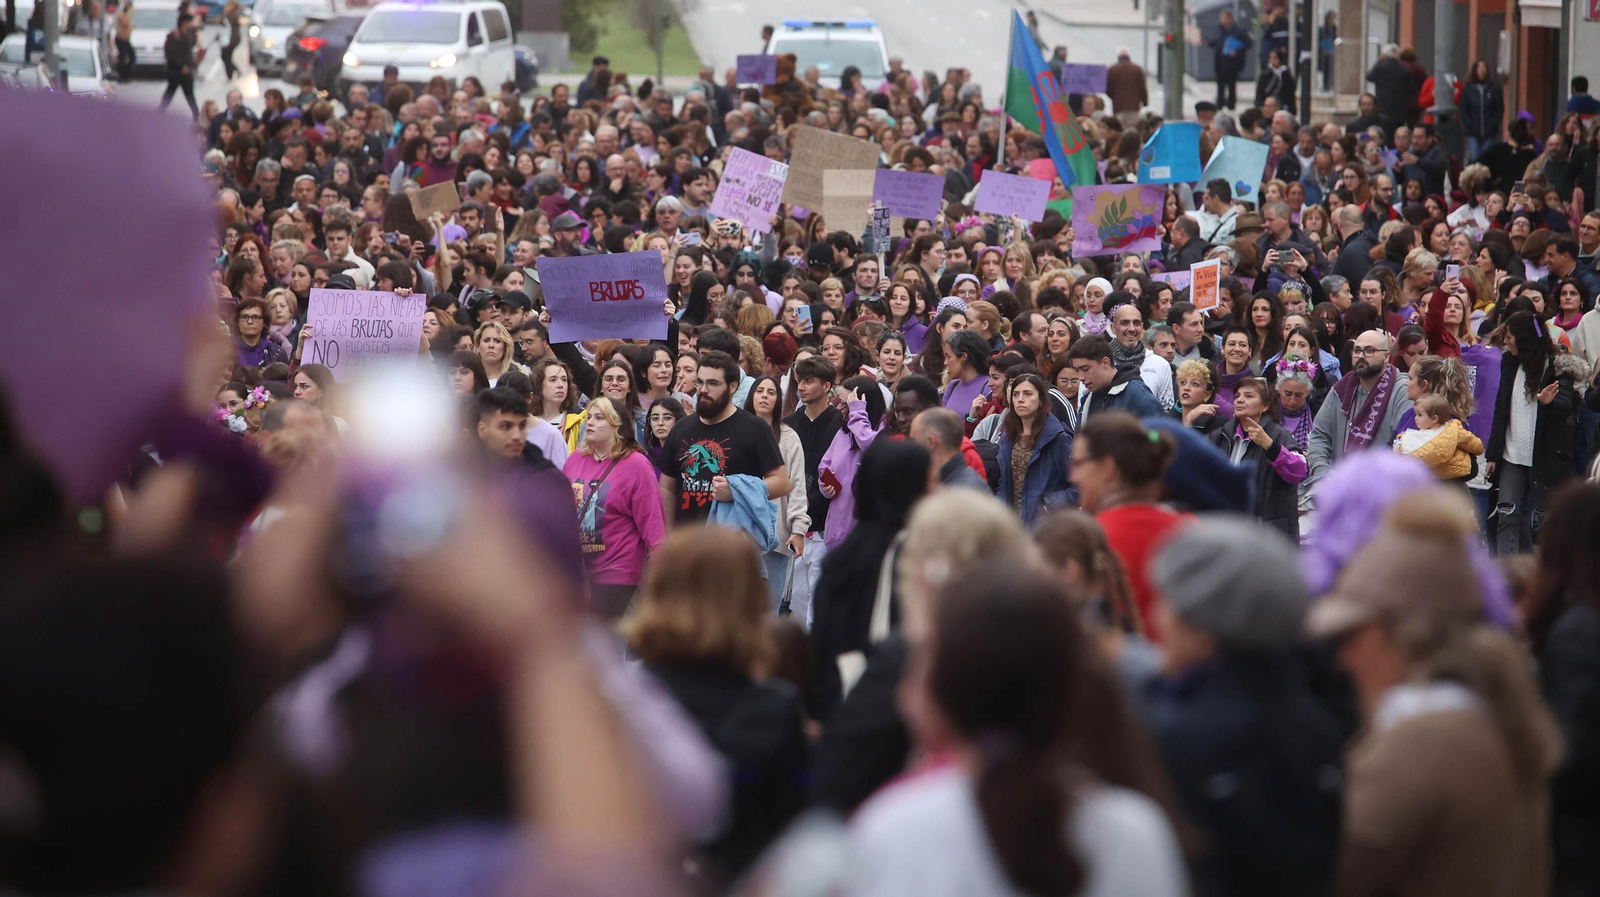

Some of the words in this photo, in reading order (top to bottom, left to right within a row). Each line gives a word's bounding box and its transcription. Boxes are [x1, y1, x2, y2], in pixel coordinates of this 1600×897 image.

[746, 194, 761, 207] NO
[594, 260, 619, 278] LAS
[318, 291, 362, 316] SOMOS
[368, 296, 385, 317] LAS
[390, 298, 423, 318] NIETAS
[313, 319, 328, 337] DE
[332, 320, 347, 337] LAS
[351, 318, 393, 339] BRUJAS
[398, 321, 417, 338] QUE
[312, 340, 340, 369] NO
[346, 341, 390, 354] PUDISTEIS
